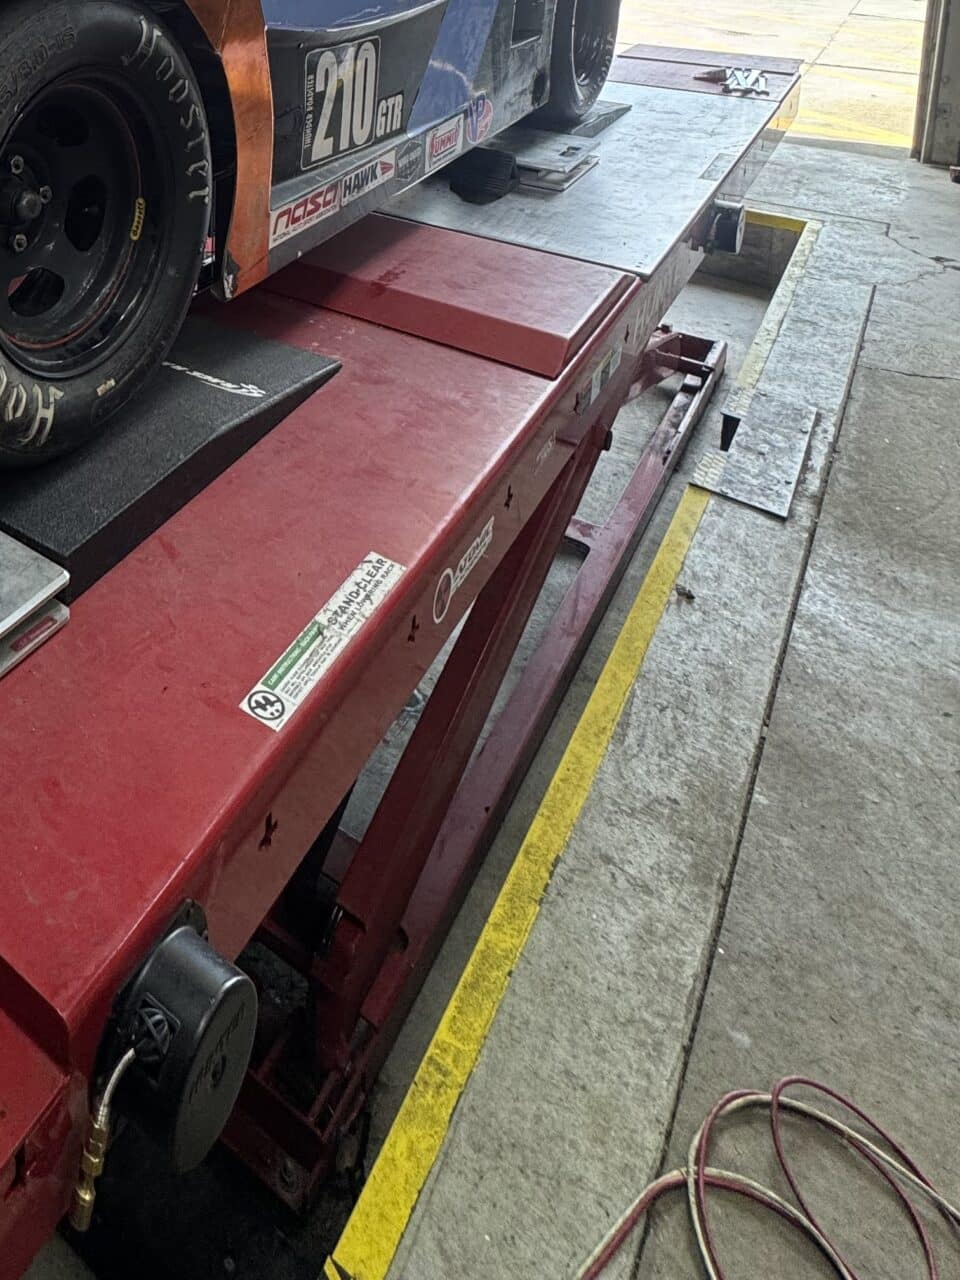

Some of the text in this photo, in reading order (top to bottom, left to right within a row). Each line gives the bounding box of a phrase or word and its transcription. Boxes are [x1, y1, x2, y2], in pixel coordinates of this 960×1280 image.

[311, 41, 403, 161] 210 GTR
[343, 160, 378, 198] HAWK
[327, 589, 360, 625] STAND
[355, 557, 387, 590] CLEAR
[339, 609, 357, 630] WHEN
[380, 563, 396, 579] RACK
